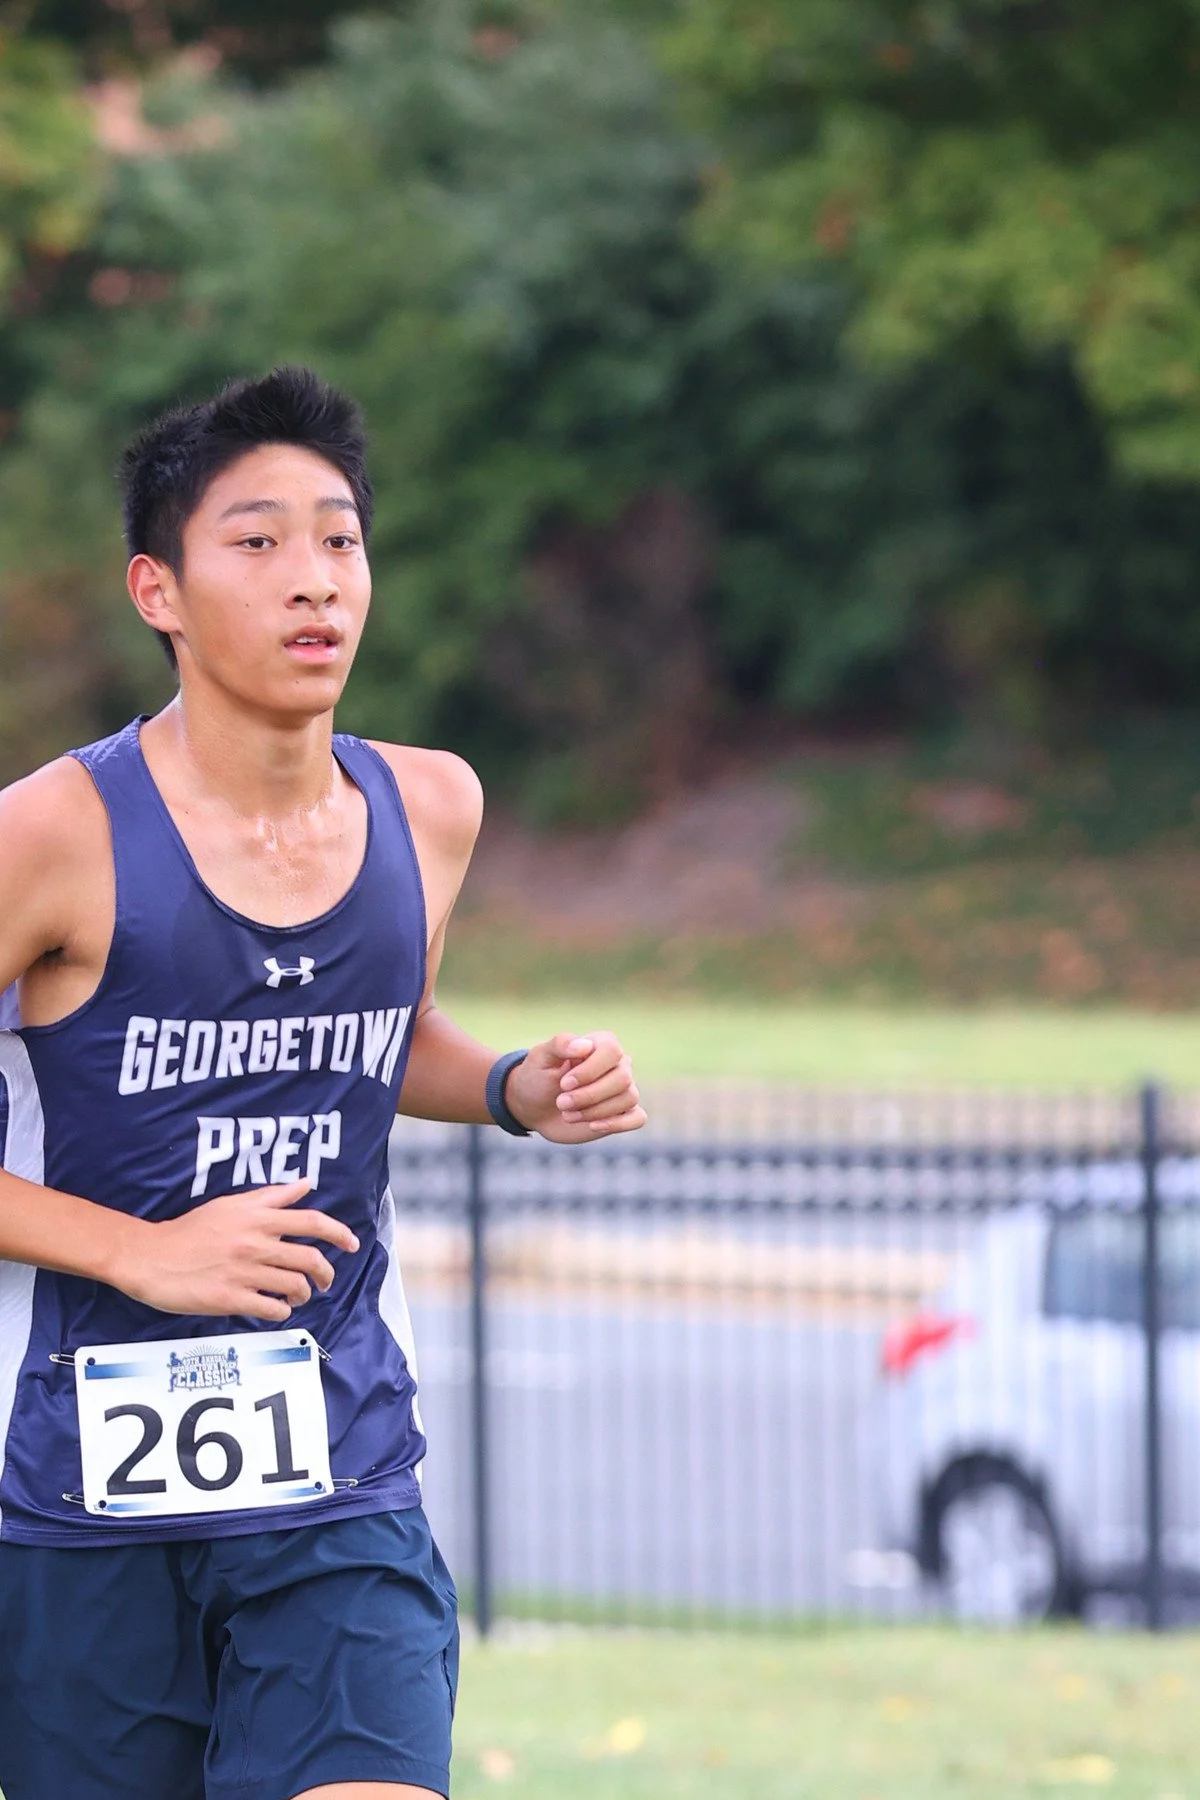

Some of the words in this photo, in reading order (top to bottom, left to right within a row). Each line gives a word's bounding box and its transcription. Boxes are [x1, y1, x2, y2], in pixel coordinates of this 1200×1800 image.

[118, 1004, 413, 1097] GEORGETOWN
[189, 1109, 342, 1199] PREP
[176, 1369, 236, 1387] CLASSIC
[104, 1390, 309, 1496] 261
